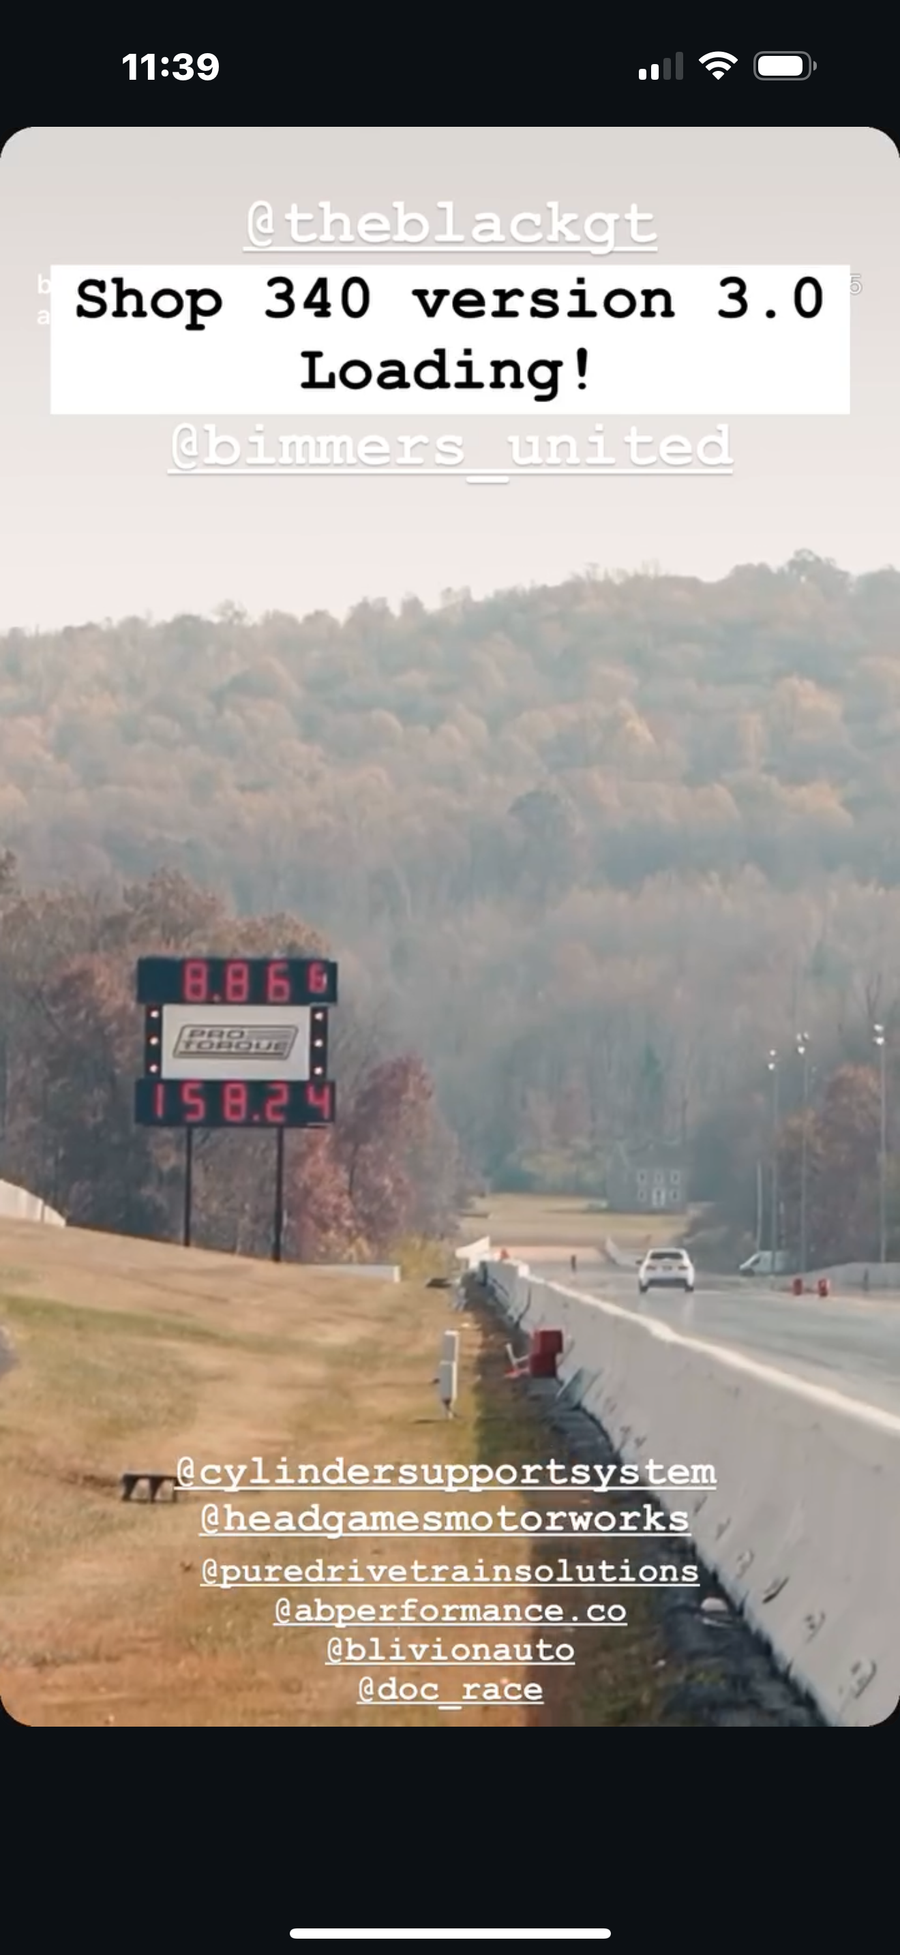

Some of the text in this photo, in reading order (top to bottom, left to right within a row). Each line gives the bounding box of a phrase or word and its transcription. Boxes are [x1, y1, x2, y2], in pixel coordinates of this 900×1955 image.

[188, 1029, 245, 1040] PRO
[182, 1040, 289, 1051] TORQUE
[155, 1081, 331, 1123] 158.24
